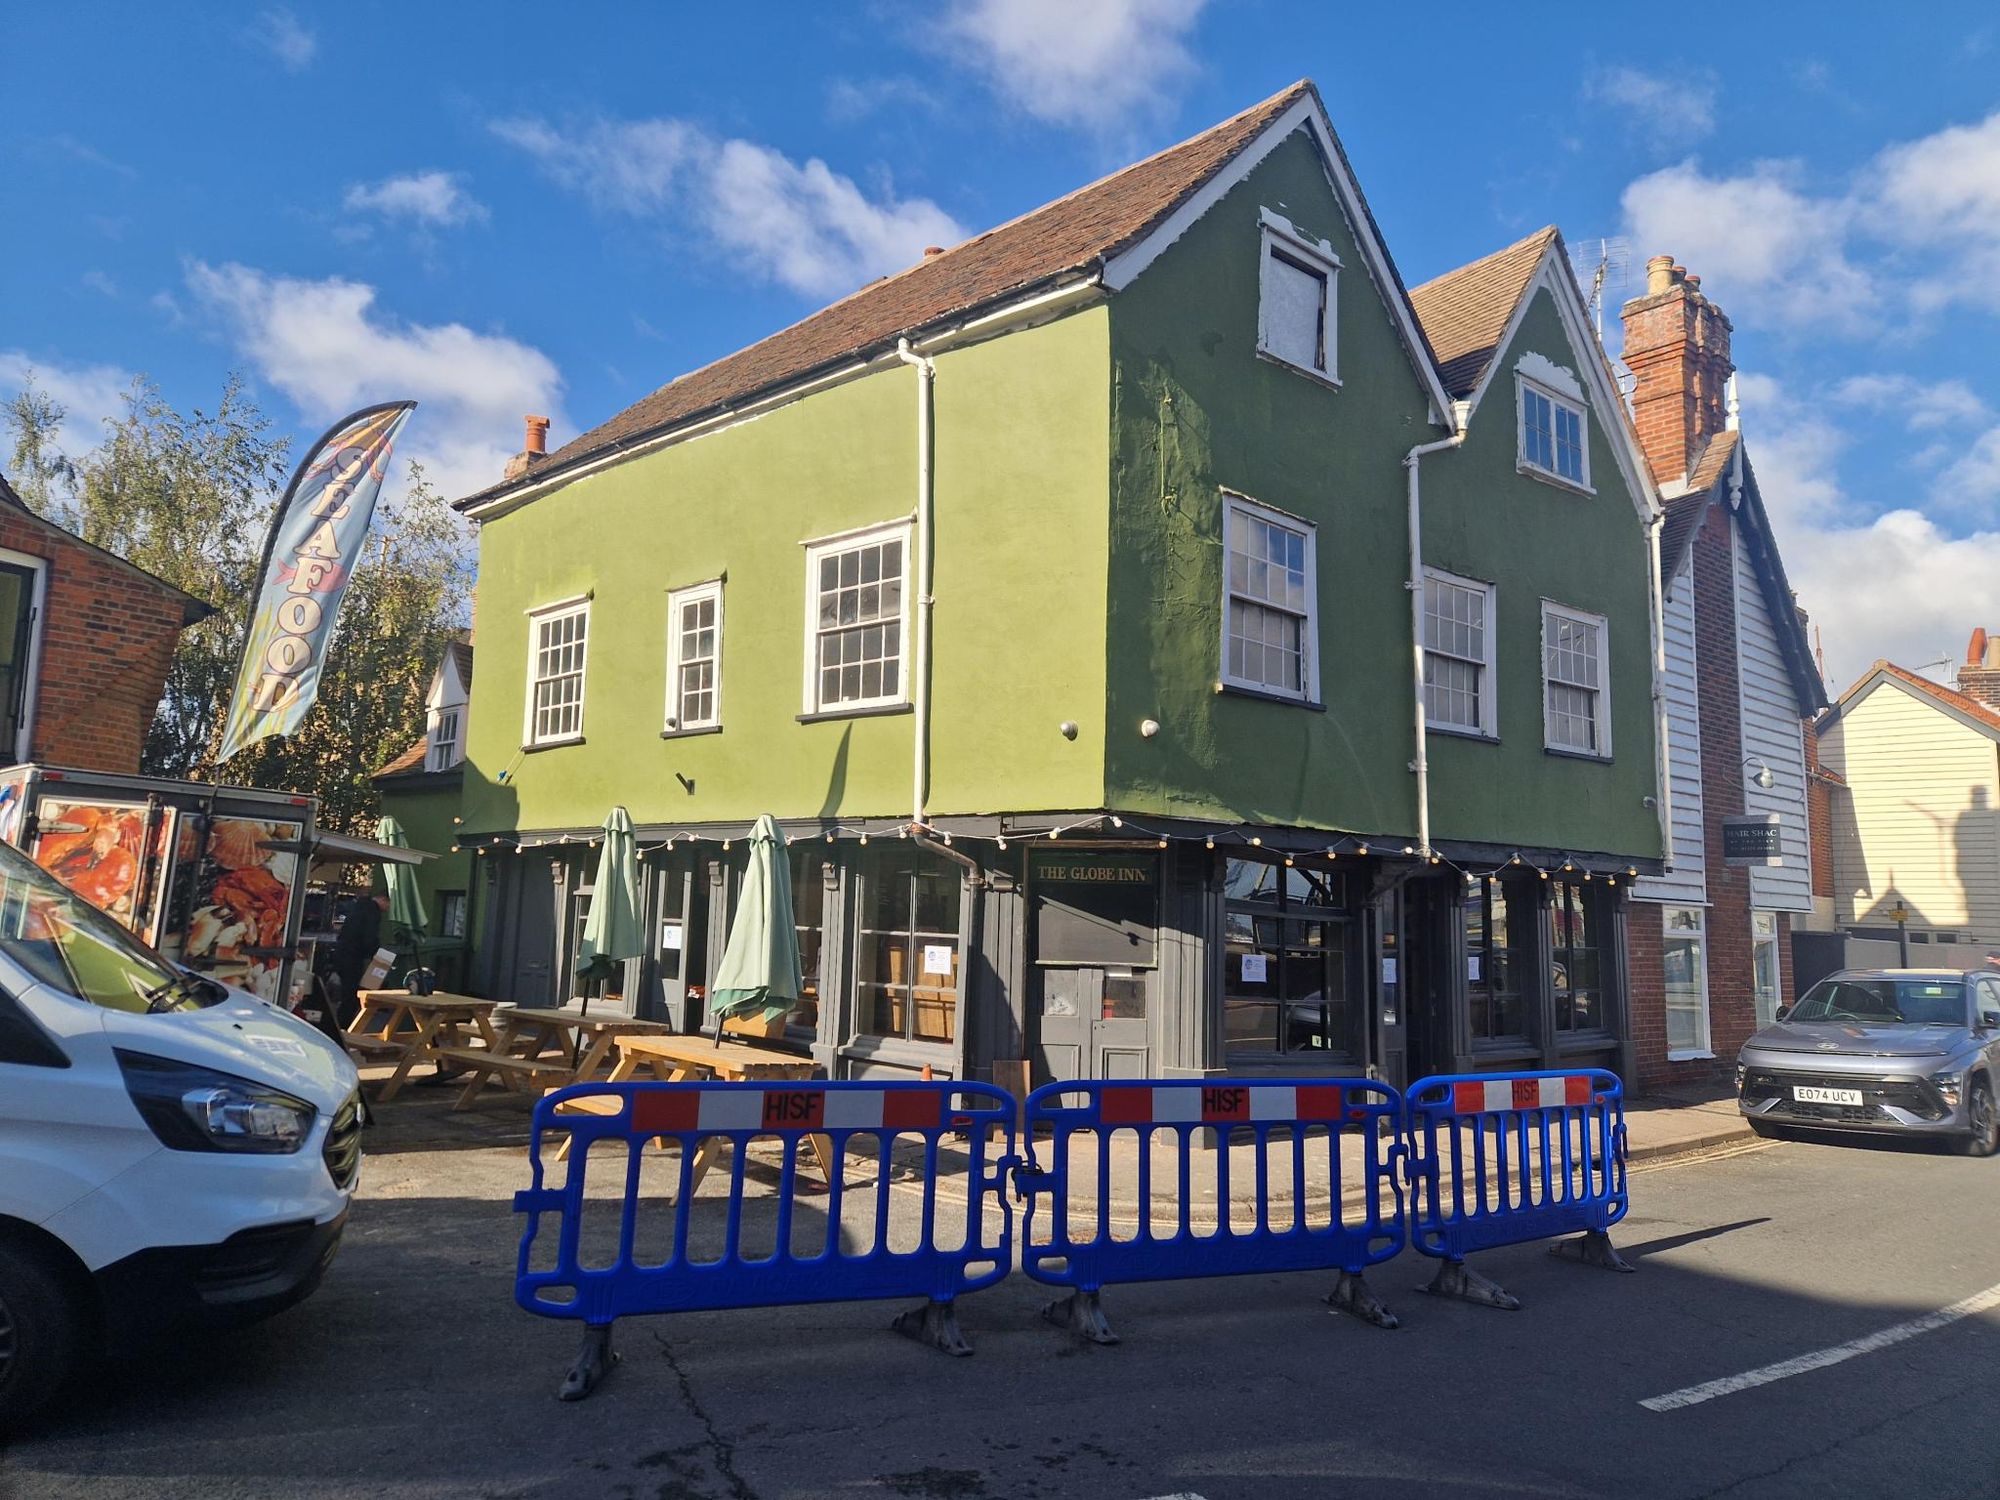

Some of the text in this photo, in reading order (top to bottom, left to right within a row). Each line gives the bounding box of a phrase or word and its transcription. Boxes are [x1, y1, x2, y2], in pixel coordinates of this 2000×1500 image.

[252, 445, 363, 713] SEAFOOD
[1039, 866, 1147, 882] THE GLOBE INN
[1832, 1091, 1856, 1102] UCV
